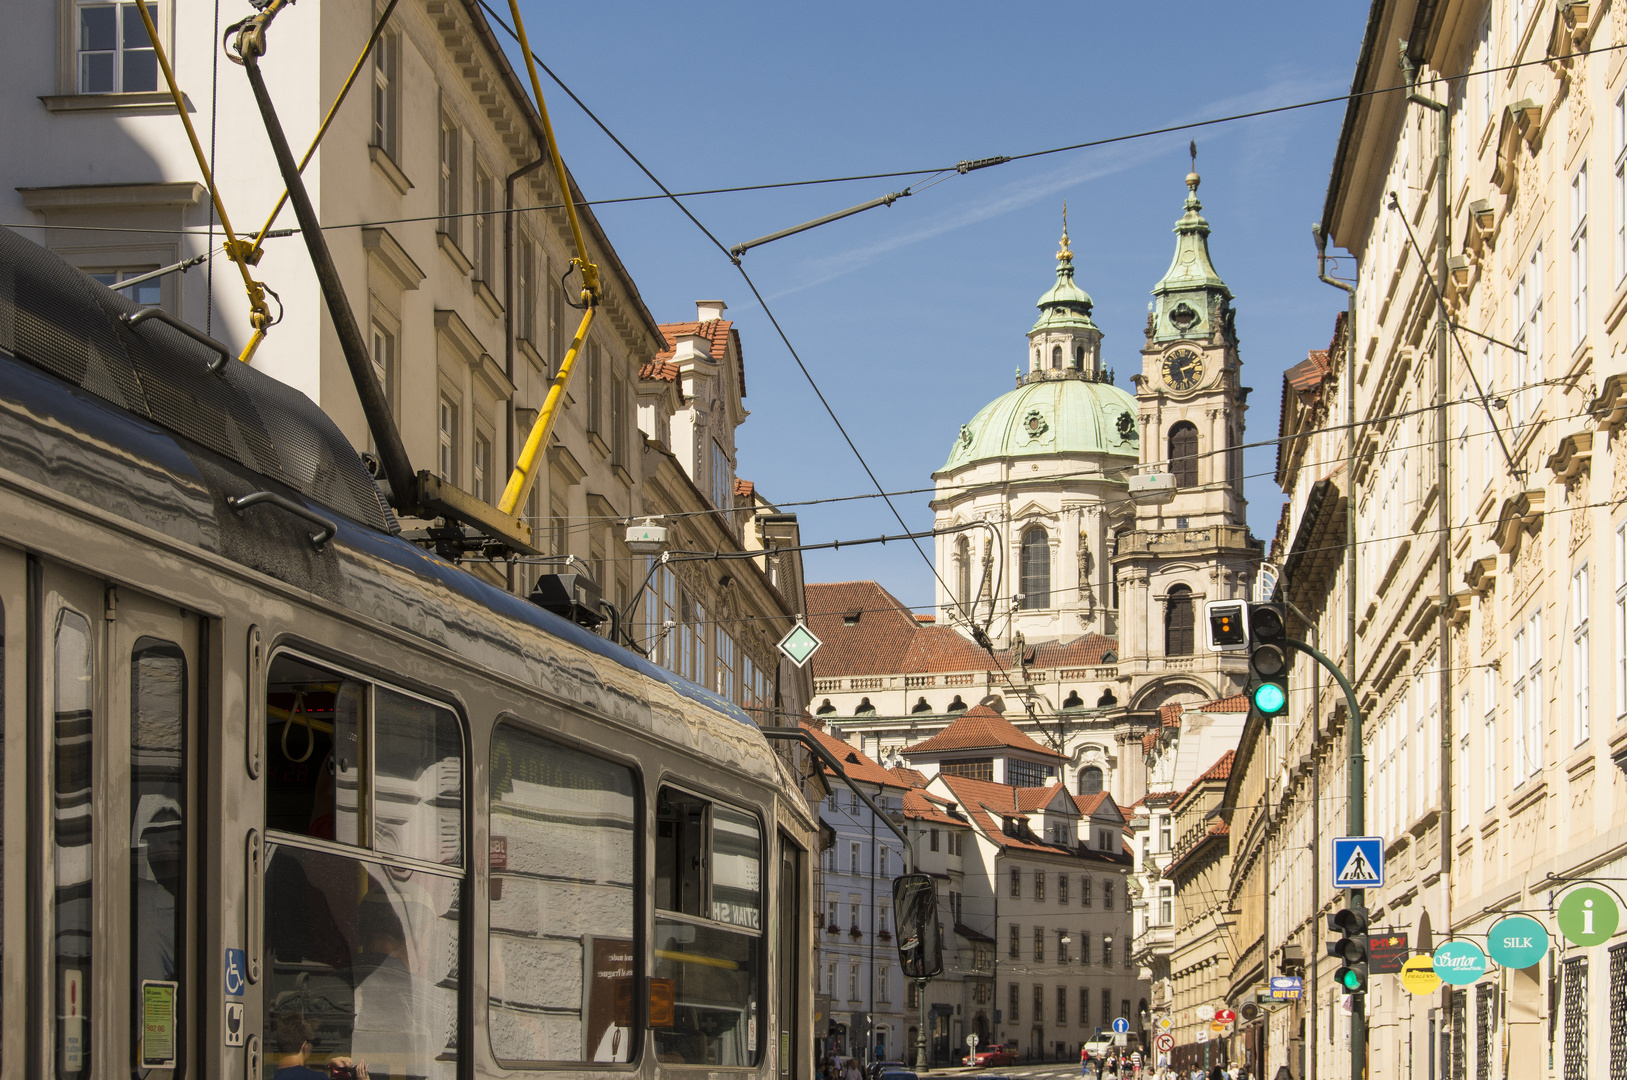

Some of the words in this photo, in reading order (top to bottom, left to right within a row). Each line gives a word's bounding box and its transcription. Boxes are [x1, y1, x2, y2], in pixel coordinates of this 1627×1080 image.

[1582, 899, 1595, 934] i
[1503, 937, 1533, 948] SILK
[1433, 952, 1477, 967] Sartor
